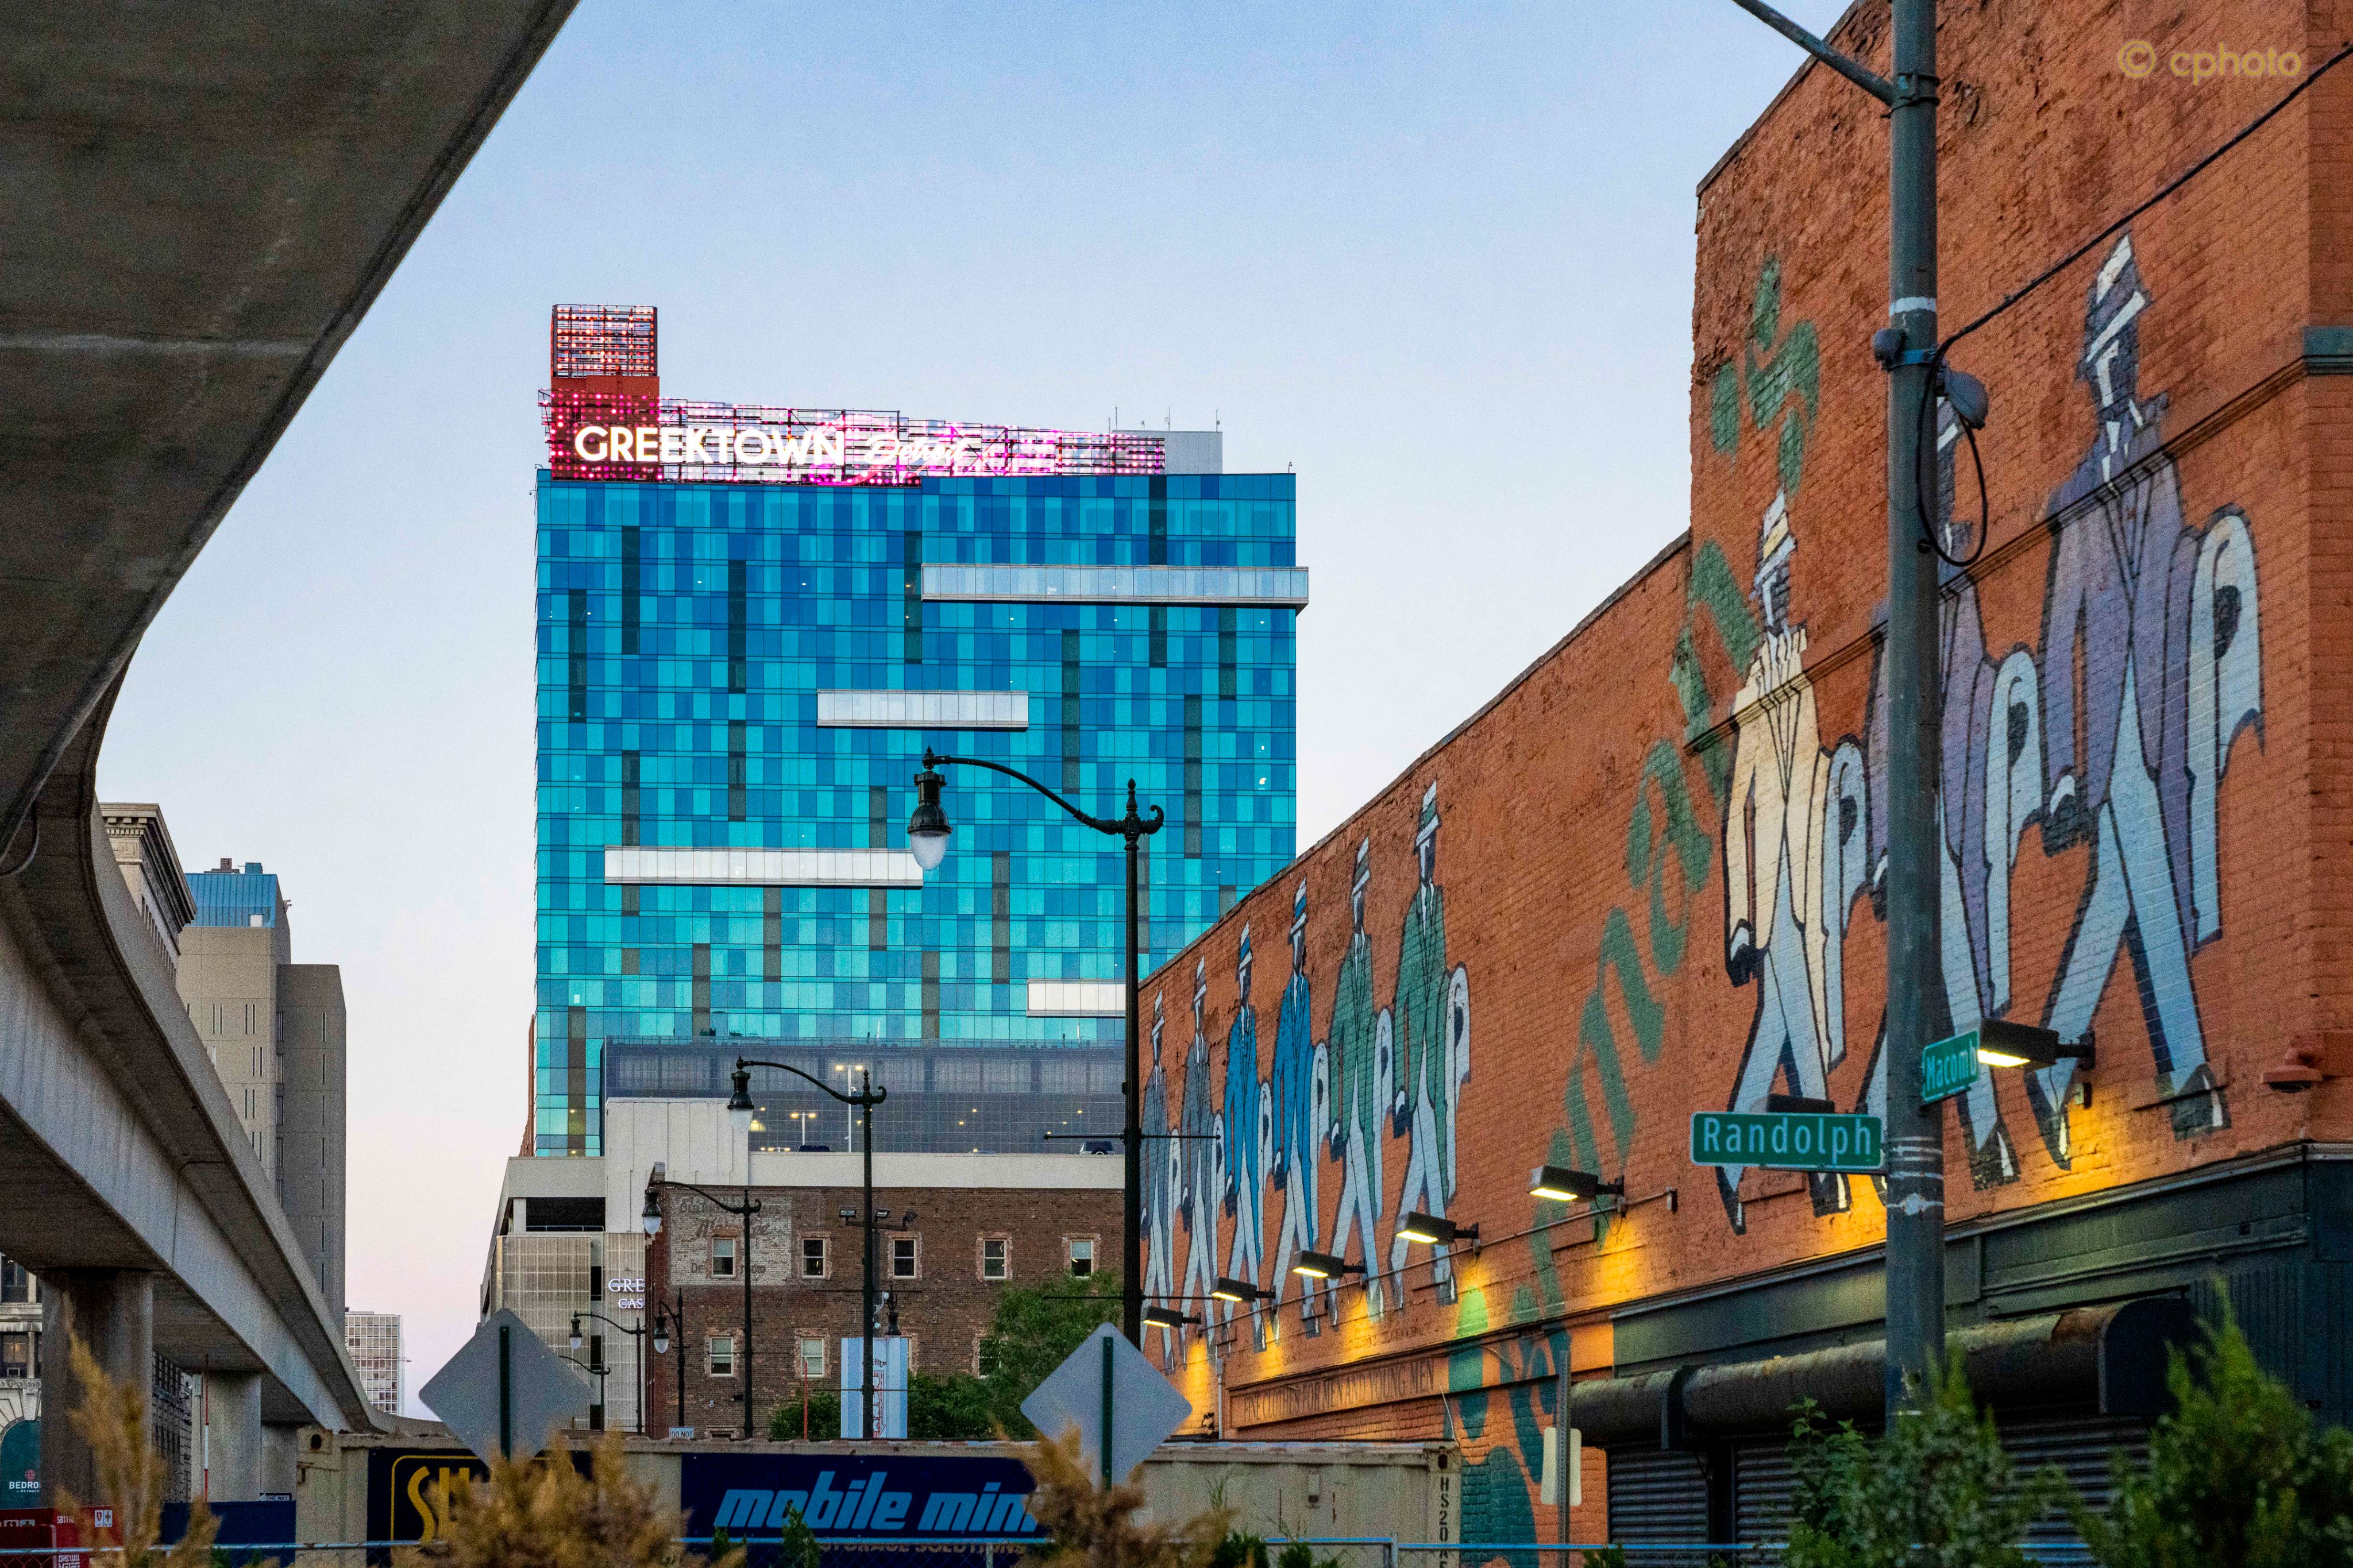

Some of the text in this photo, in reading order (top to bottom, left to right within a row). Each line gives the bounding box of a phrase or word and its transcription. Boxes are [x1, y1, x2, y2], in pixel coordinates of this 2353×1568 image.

[574, 425, 980, 466] GREEKTOWN Detroit
[1926, 1038, 1977, 1092] Macomb
[1703, 1115, 1872, 1166] Randolph
[618, 1298, 646, 1309] CAS
[1243, 1395, 1260, 1423] FINE
[1302, 1382, 1320, 1412] FOR
[1323, 1377, 1343, 1409] MEN
[1345, 1373, 1367, 1404] AND
[1369, 1364, 1406, 1400] YOUNG
[1410, 1358, 1434, 1393] MEN
[9, 1481, 41, 1489] BEDRO
[714, 1471, 913, 1530] mobile
